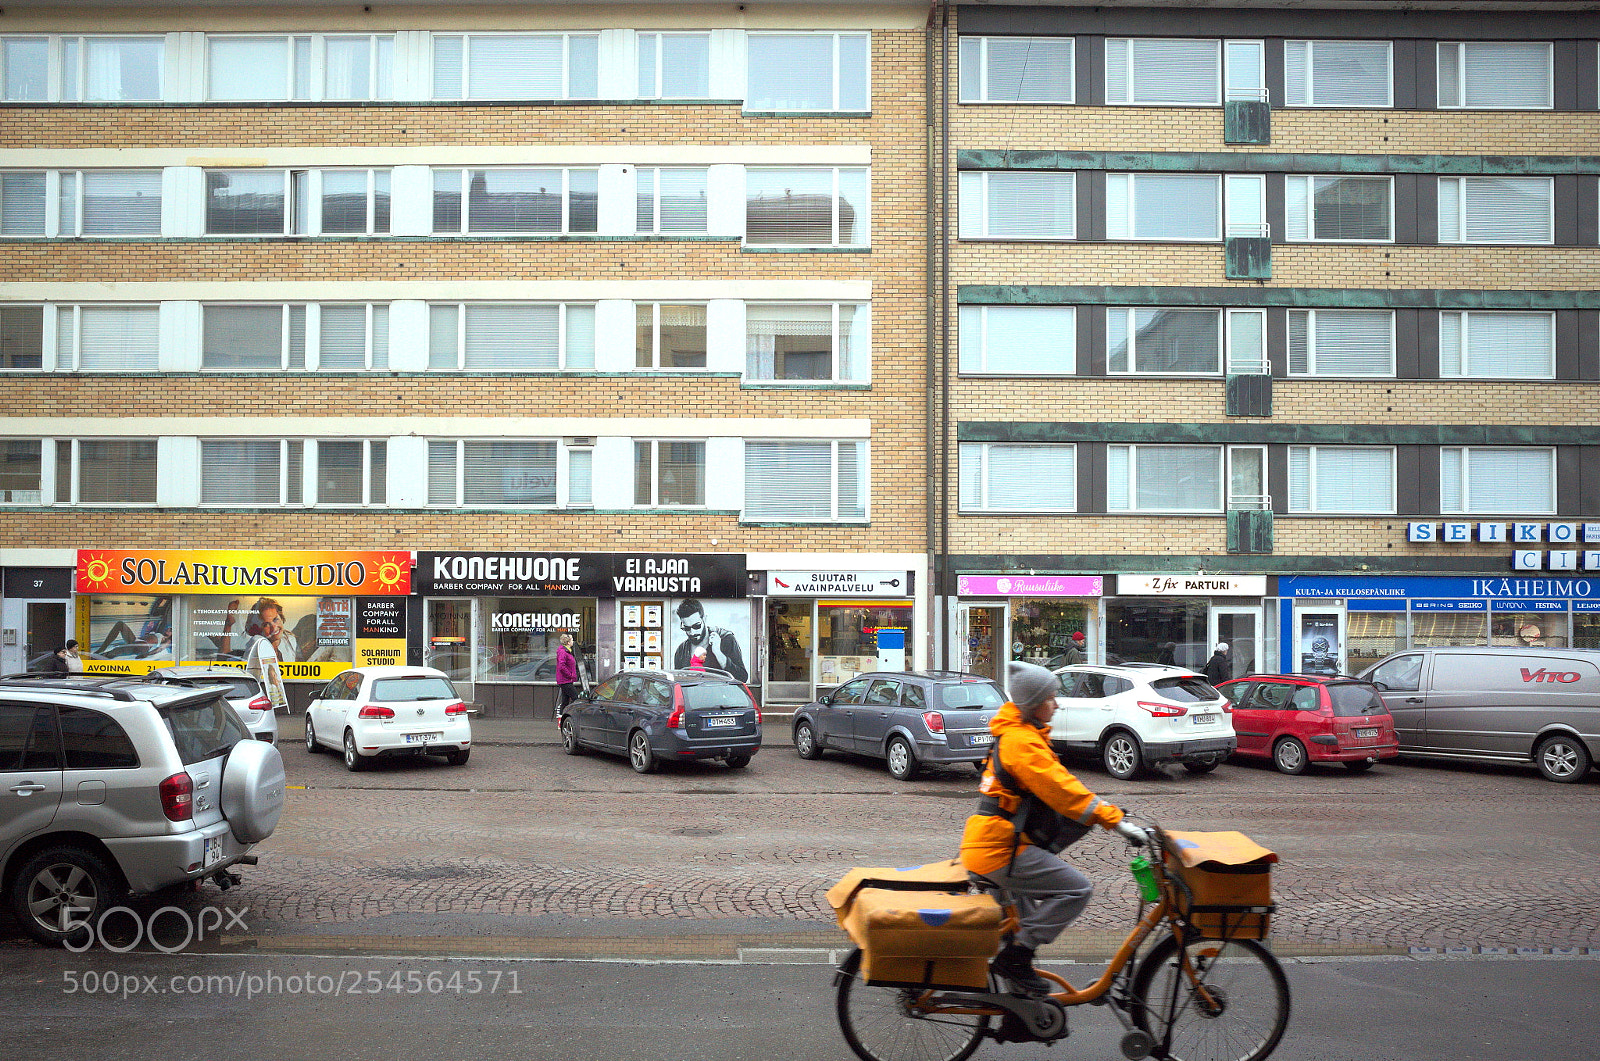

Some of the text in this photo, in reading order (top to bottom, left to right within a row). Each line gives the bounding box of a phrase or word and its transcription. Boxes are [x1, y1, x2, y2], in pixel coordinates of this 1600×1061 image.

[1416, 524, 1571, 540] SEIKO
[433, 556, 580, 581] KONEHUONE
[626, 559, 688, 574] EI AJAN
[121, 557, 365, 586] SOLARIUMSTUDIO
[811, 574, 857, 582] SUUTARI
[33, 580, 43, 588] 37
[613, 576, 701, 593] VARAUSTA
[794, 584, 874, 592] AVAINPALVELU
[1013, 579, 1065, 593] Ruusuliike
[1185, 581, 1230, 590] PARTURI
[1471, 578, 1591, 597] IKÄHEIMO
[1335, 587, 1406, 596] KELLOSEPÄNLIIKE
[362, 610, 399, 618] COMPANY
[491, 612, 581, 628] KONEHUONE
[361, 649, 401, 657] SOLARIUM
[367, 658, 395, 666] STUDIO
[87, 664, 131, 672] AVOINNA
